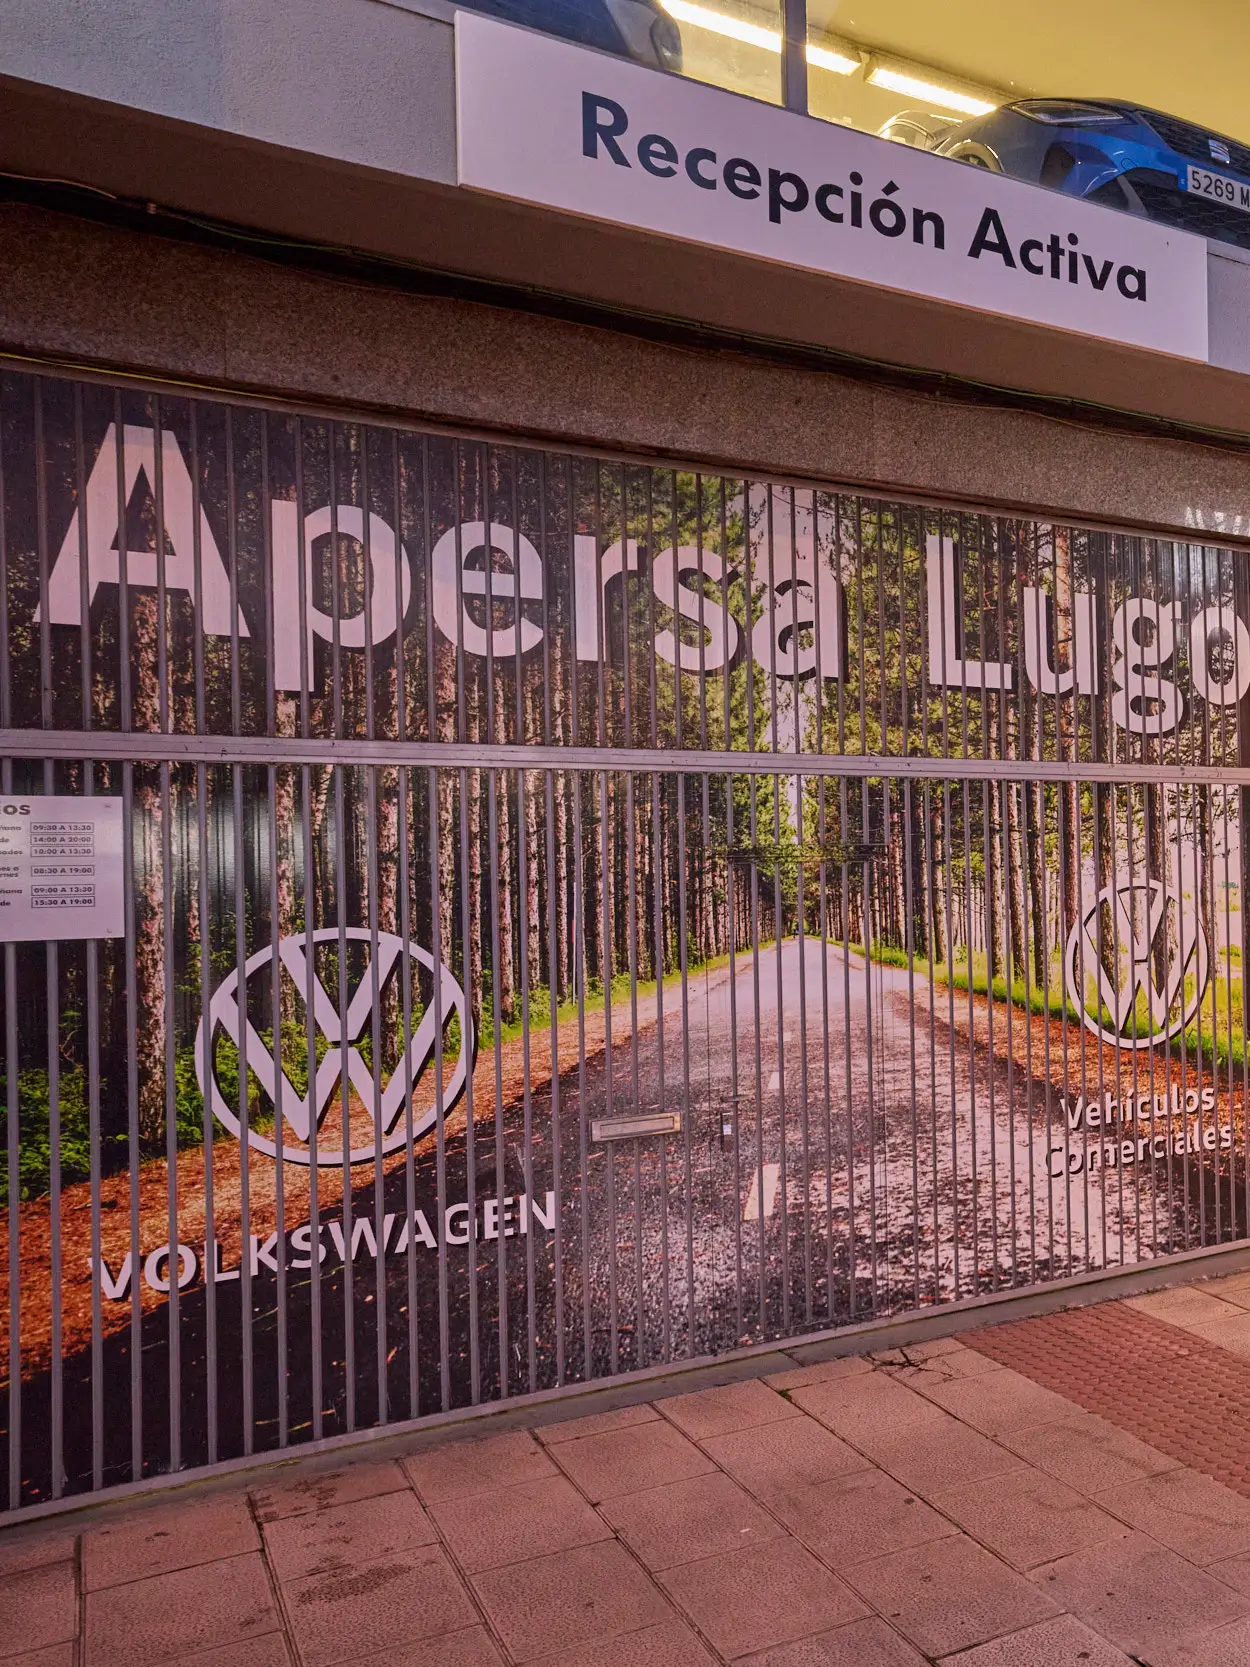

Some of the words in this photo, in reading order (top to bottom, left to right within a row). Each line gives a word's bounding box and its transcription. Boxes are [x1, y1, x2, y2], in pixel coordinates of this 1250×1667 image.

[581, 90, 946, 250] Recepción
[967, 206, 1148, 303] Activa
[1191, 170, 1235, 202] 5269
[33, 422, 846, 692] Apersa
[926, 534, 1250, 735] Lugo
[1060, 1083, 1216, 1130] Vehículos
[1045, 1120, 1234, 1179] Comerciales
[87, 1190, 558, 1302] VOLKSWAGEN
